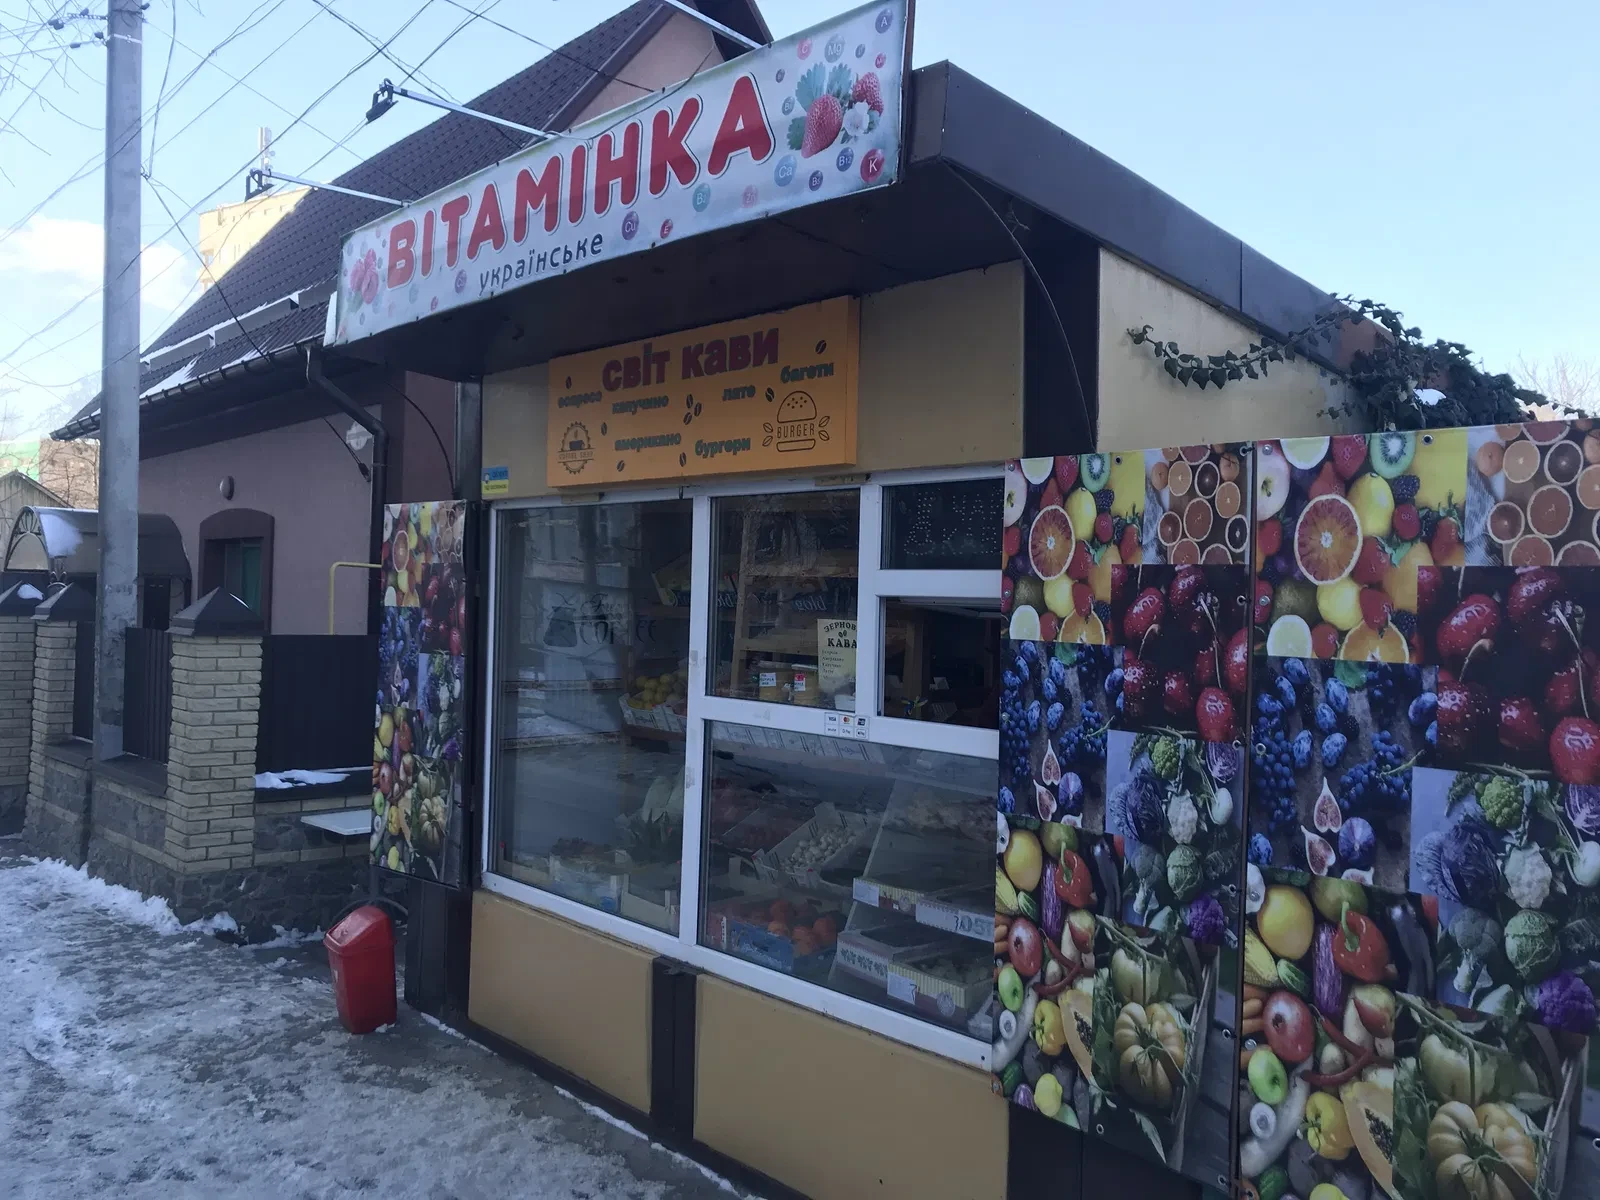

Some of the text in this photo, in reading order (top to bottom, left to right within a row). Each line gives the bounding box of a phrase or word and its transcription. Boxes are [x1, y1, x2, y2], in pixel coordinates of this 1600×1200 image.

[828, 43, 842, 56] Mg
[778, 165, 793, 178] Ca
[387, 74, 776, 290] ВІТАМІНКА
[478, 232, 605, 296] українське
[602, 328, 779, 392] світ кави
[777, 423, 815, 439] BURGER
[695, 438, 751, 459] бургери
[823, 621, 857, 633] ЗЕРНОВ
[827, 638, 857, 648] КАВА
